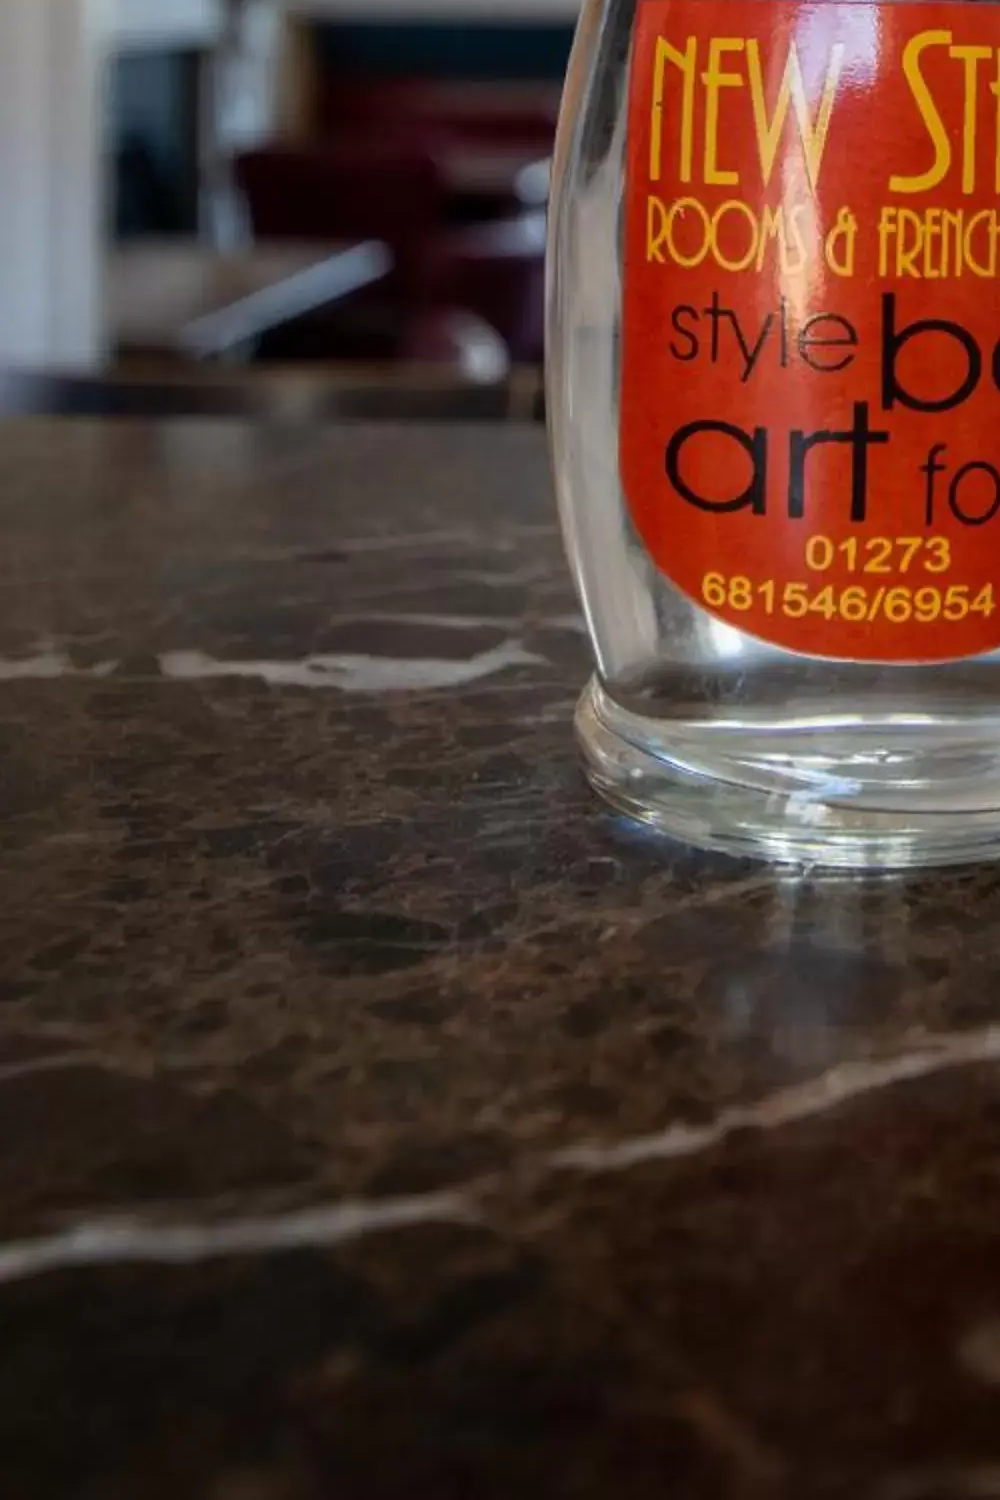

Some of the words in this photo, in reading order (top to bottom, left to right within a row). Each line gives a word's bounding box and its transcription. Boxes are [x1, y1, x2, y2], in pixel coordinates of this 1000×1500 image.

[648, 35, 845, 194] NEW
[646, 195, 808, 274] ROOMS
[826, 207, 858, 277] &
[669, 291, 859, 382] style
[665, 401, 889, 522] art
[805, 535, 952, 573] 01273
